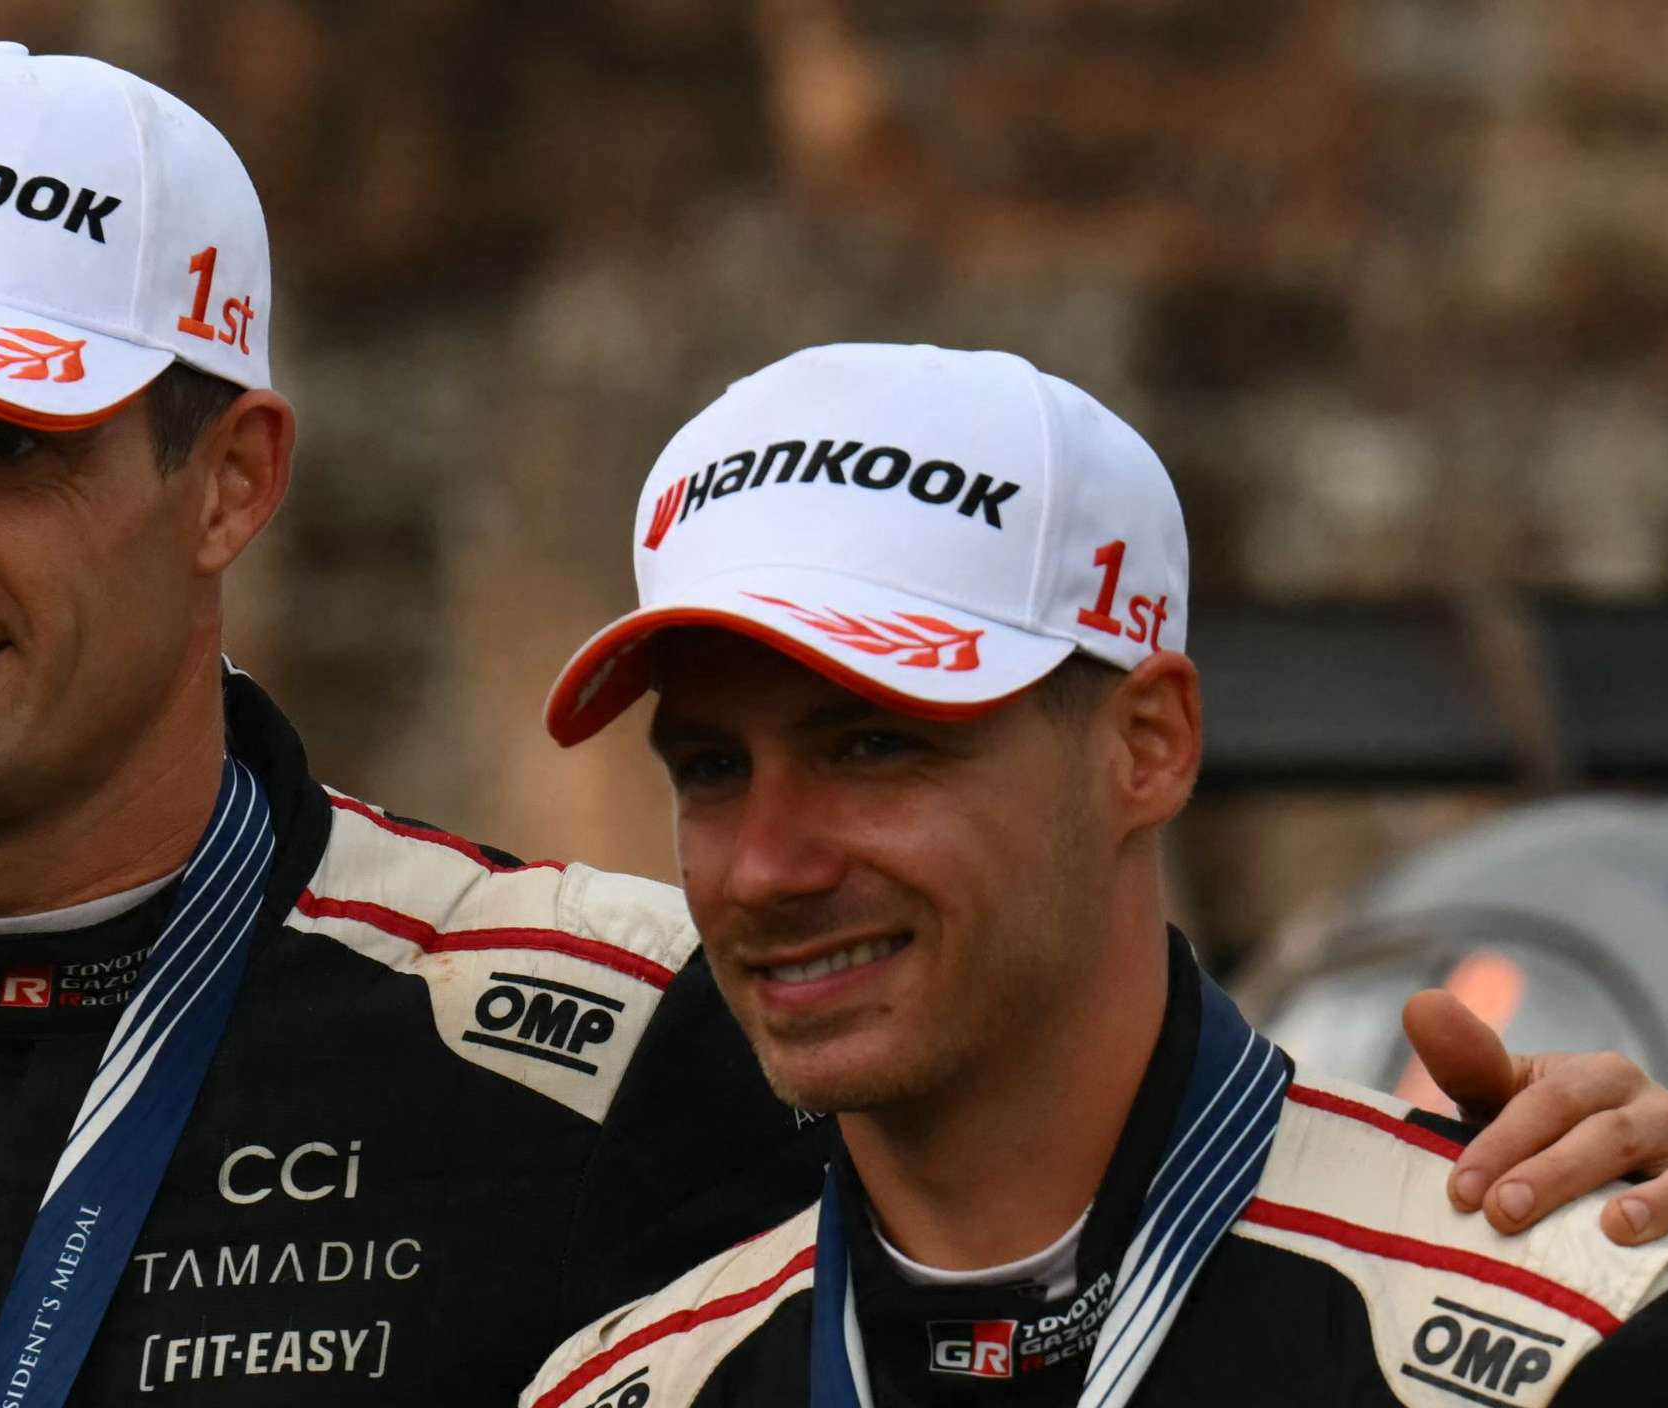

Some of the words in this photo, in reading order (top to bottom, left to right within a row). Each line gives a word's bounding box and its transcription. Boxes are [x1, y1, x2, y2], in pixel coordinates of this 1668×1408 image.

[178, 246, 254, 355] 1st
[1078, 539, 1168, 653] 1st
[474, 985, 614, 1055] OMP
[55, 1204, 101, 1294] MEDAL
[134, 1238, 422, 1294] TAMADIC
[934, 1337, 1010, 1376] GR
[1412, 1314, 1551, 1397] OMP
